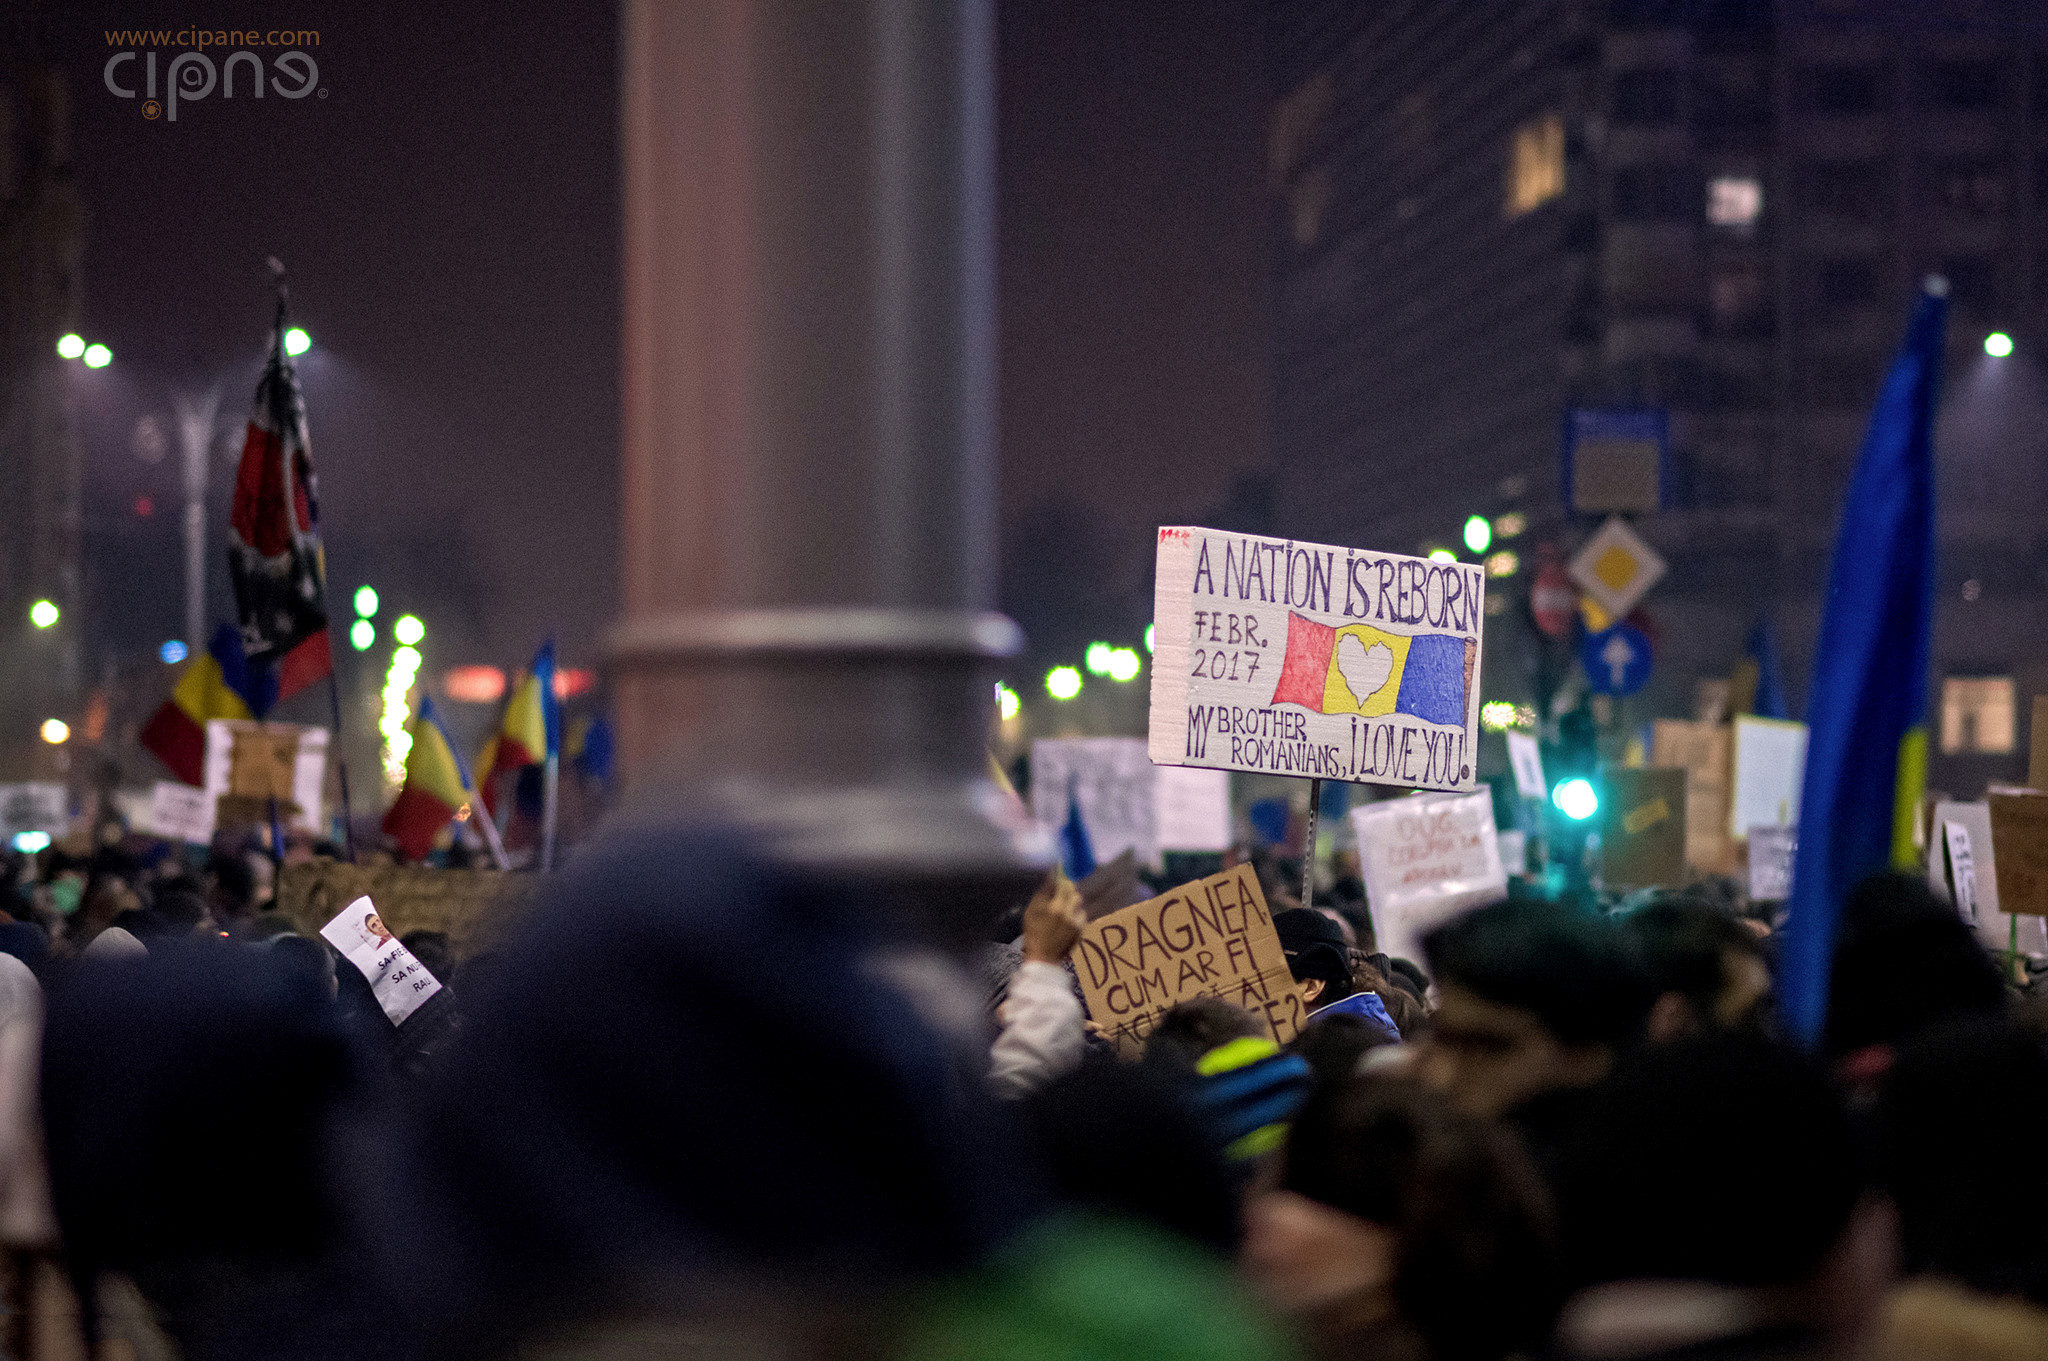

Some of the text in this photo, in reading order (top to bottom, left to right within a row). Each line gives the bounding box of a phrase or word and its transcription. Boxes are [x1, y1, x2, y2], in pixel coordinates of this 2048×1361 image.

[1193, 538, 1214, 595] A
[1224, 539, 1334, 613] NATION
[1375, 559, 1482, 633] REBORN
[1195, 611, 1268, 648] FEBR.
[1191, 649, 1260, 683] 2017
[1186, 705, 1307, 759] MY BROTHER
[1363, 723, 1417, 782] LOVE
[1231, 736, 1347, 779] ROMANIANS,
[391, 970, 408, 984] SA
[1107, 935, 1258, 1015] CUM AR FI
